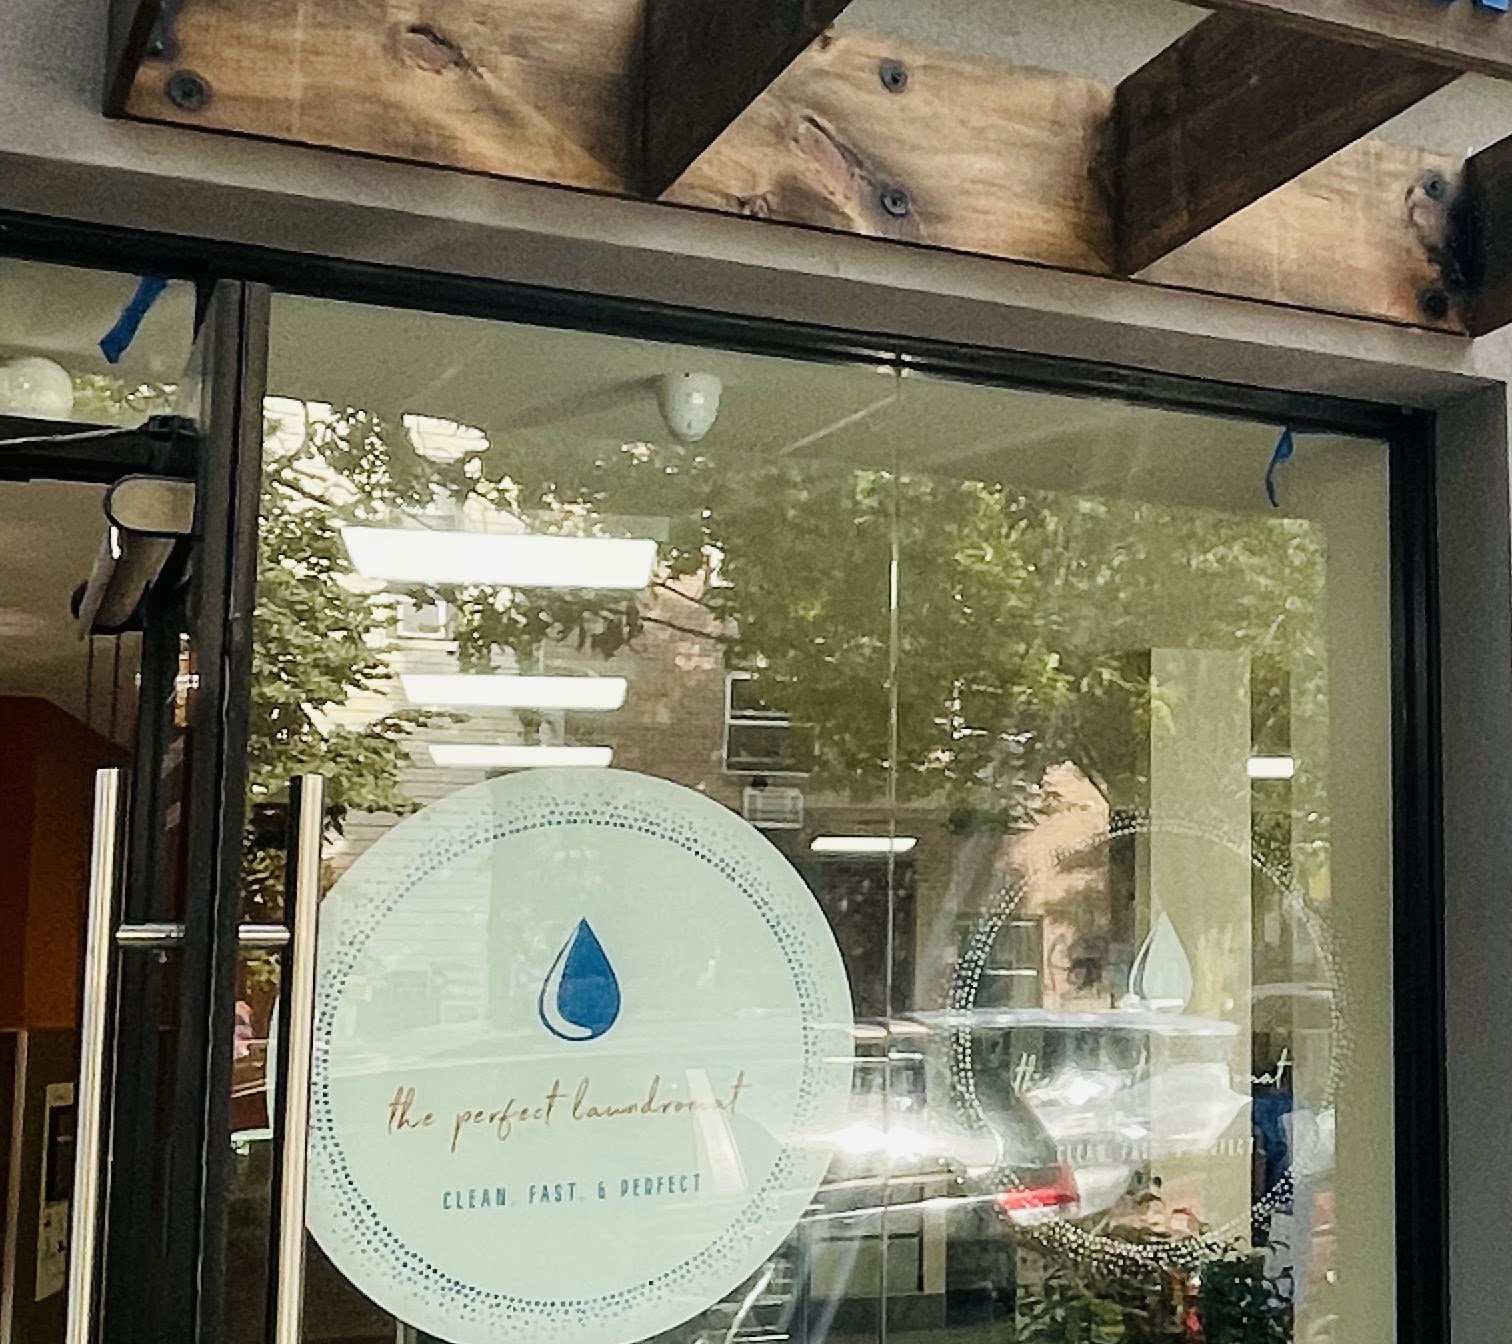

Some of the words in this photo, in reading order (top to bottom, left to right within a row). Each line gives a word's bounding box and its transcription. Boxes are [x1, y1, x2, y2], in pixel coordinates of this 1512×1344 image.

[387, 1085, 437, 1136] the
[450, 1079, 568, 1154] perfect
[619, 1172, 701, 1198] PERFECT
